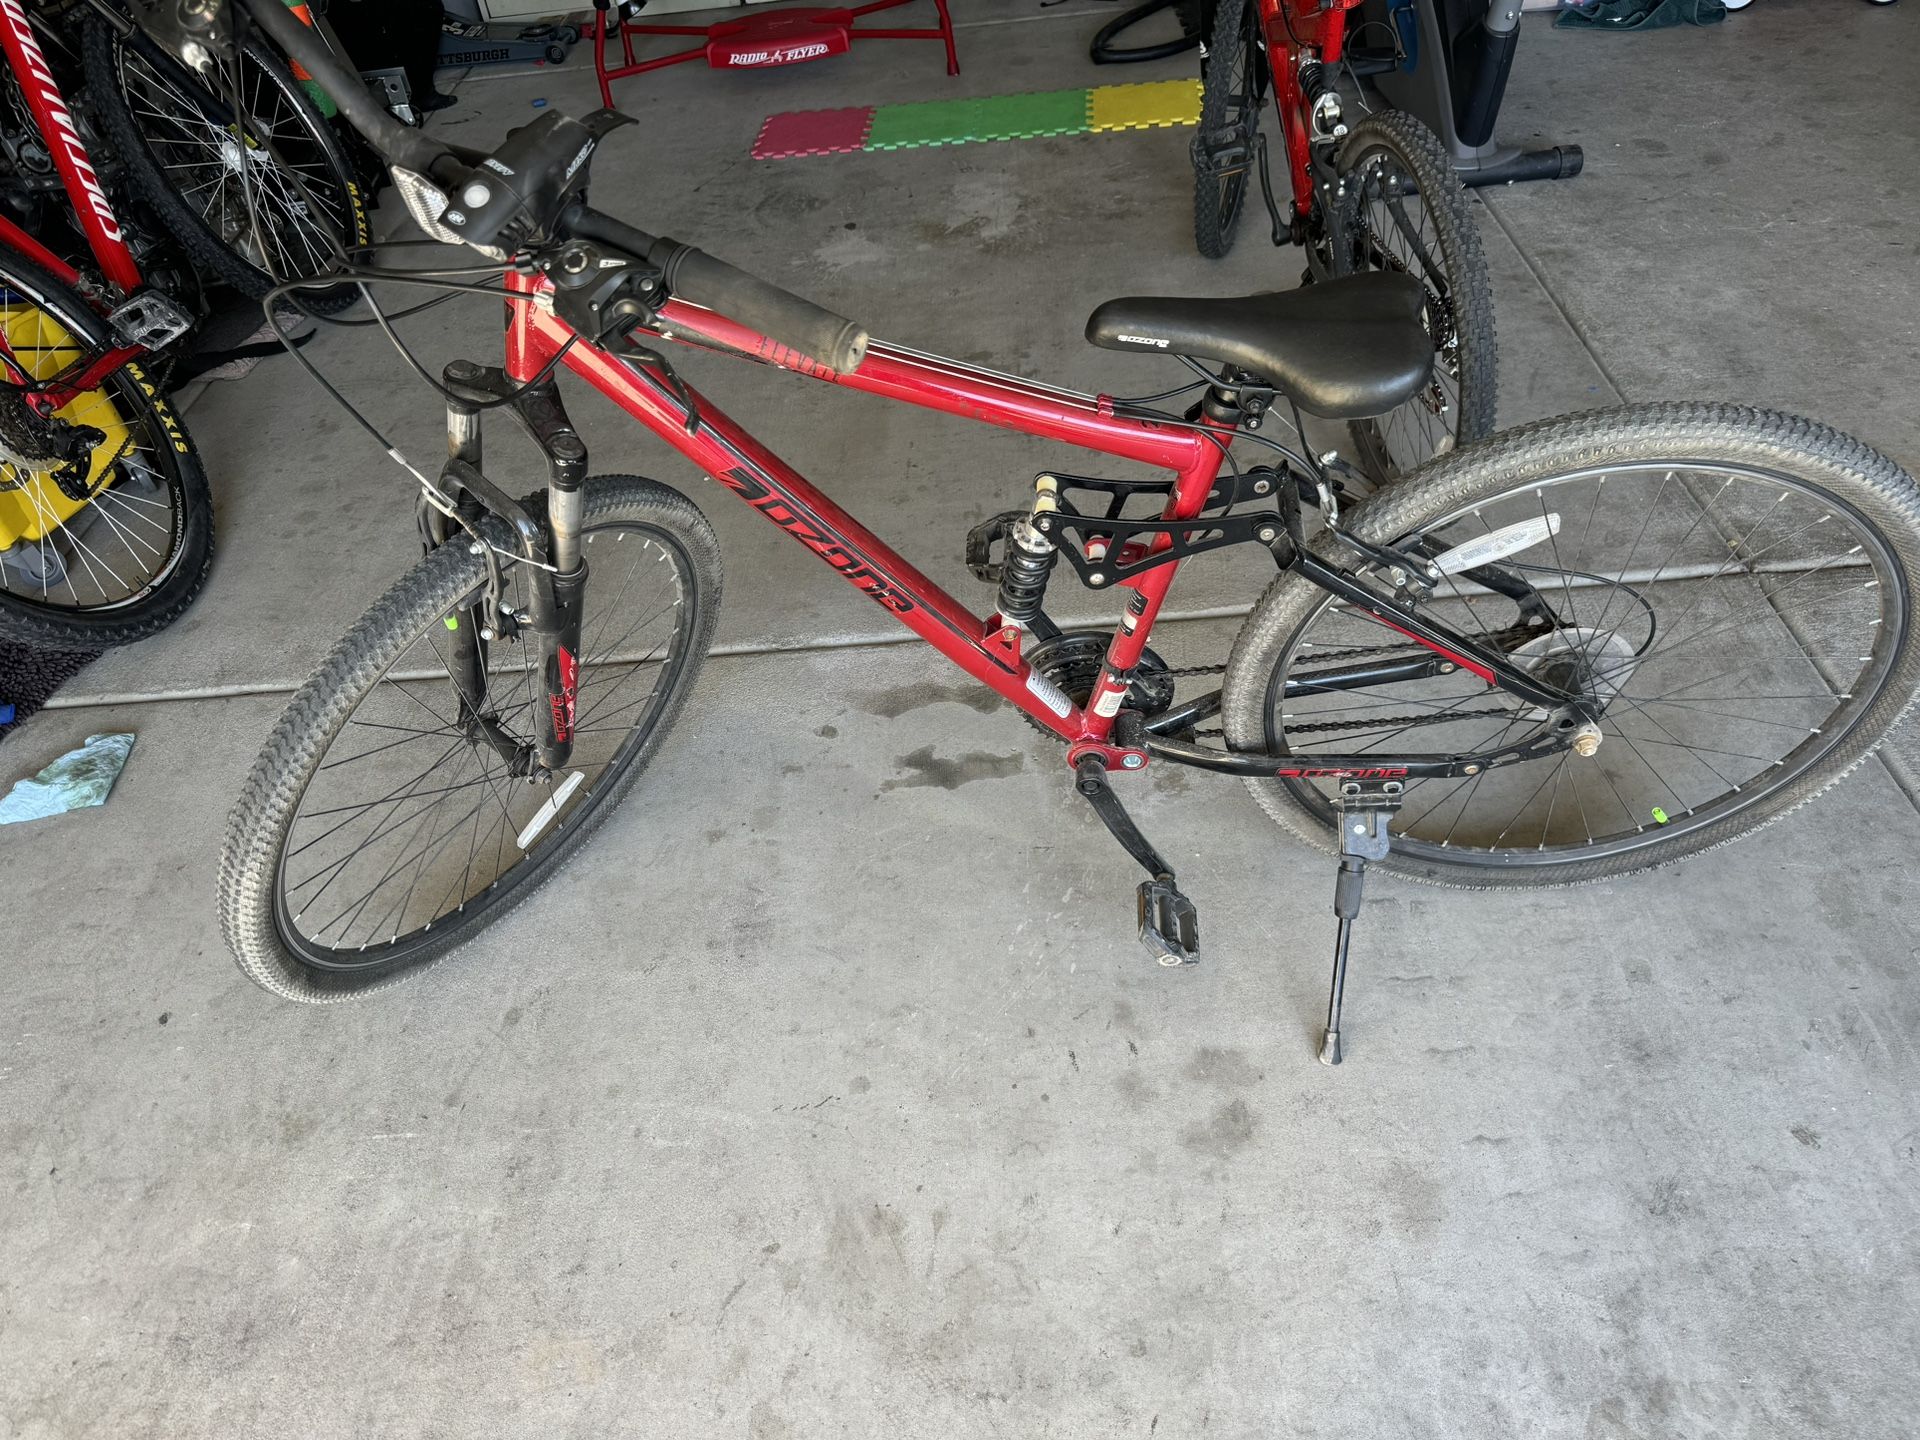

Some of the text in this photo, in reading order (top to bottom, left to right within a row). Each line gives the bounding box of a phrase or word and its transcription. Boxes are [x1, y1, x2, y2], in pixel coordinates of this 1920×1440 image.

[437, 48, 510, 65] TTSBURGH
[728, 43, 828, 65] RADIO FLYER
[347, 181, 368, 247] MAXXIS
[126, 362, 188, 453] MAXXIS
